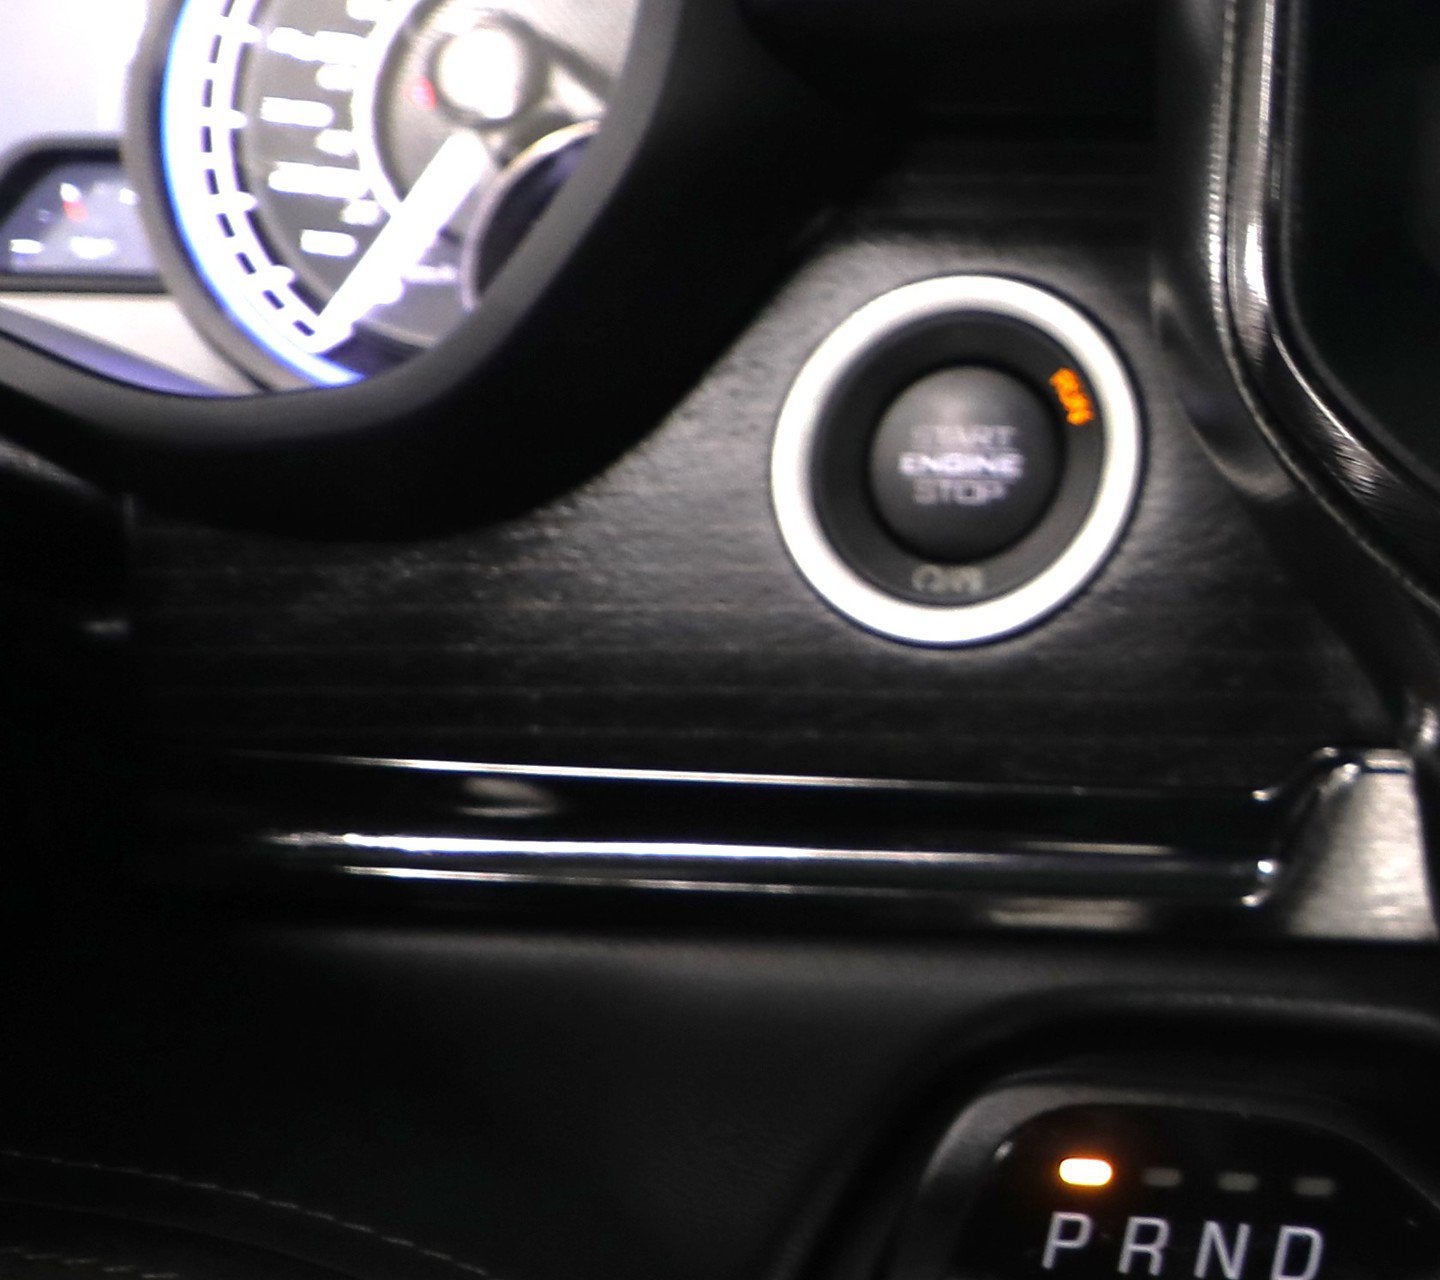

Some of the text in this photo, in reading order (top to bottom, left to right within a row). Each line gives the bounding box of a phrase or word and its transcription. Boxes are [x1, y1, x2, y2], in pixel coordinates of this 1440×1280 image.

[913, 479, 1007, 505] STOP
[1041, 1211, 1093, 1271] P
[1117, 1217, 1170, 1276] R
